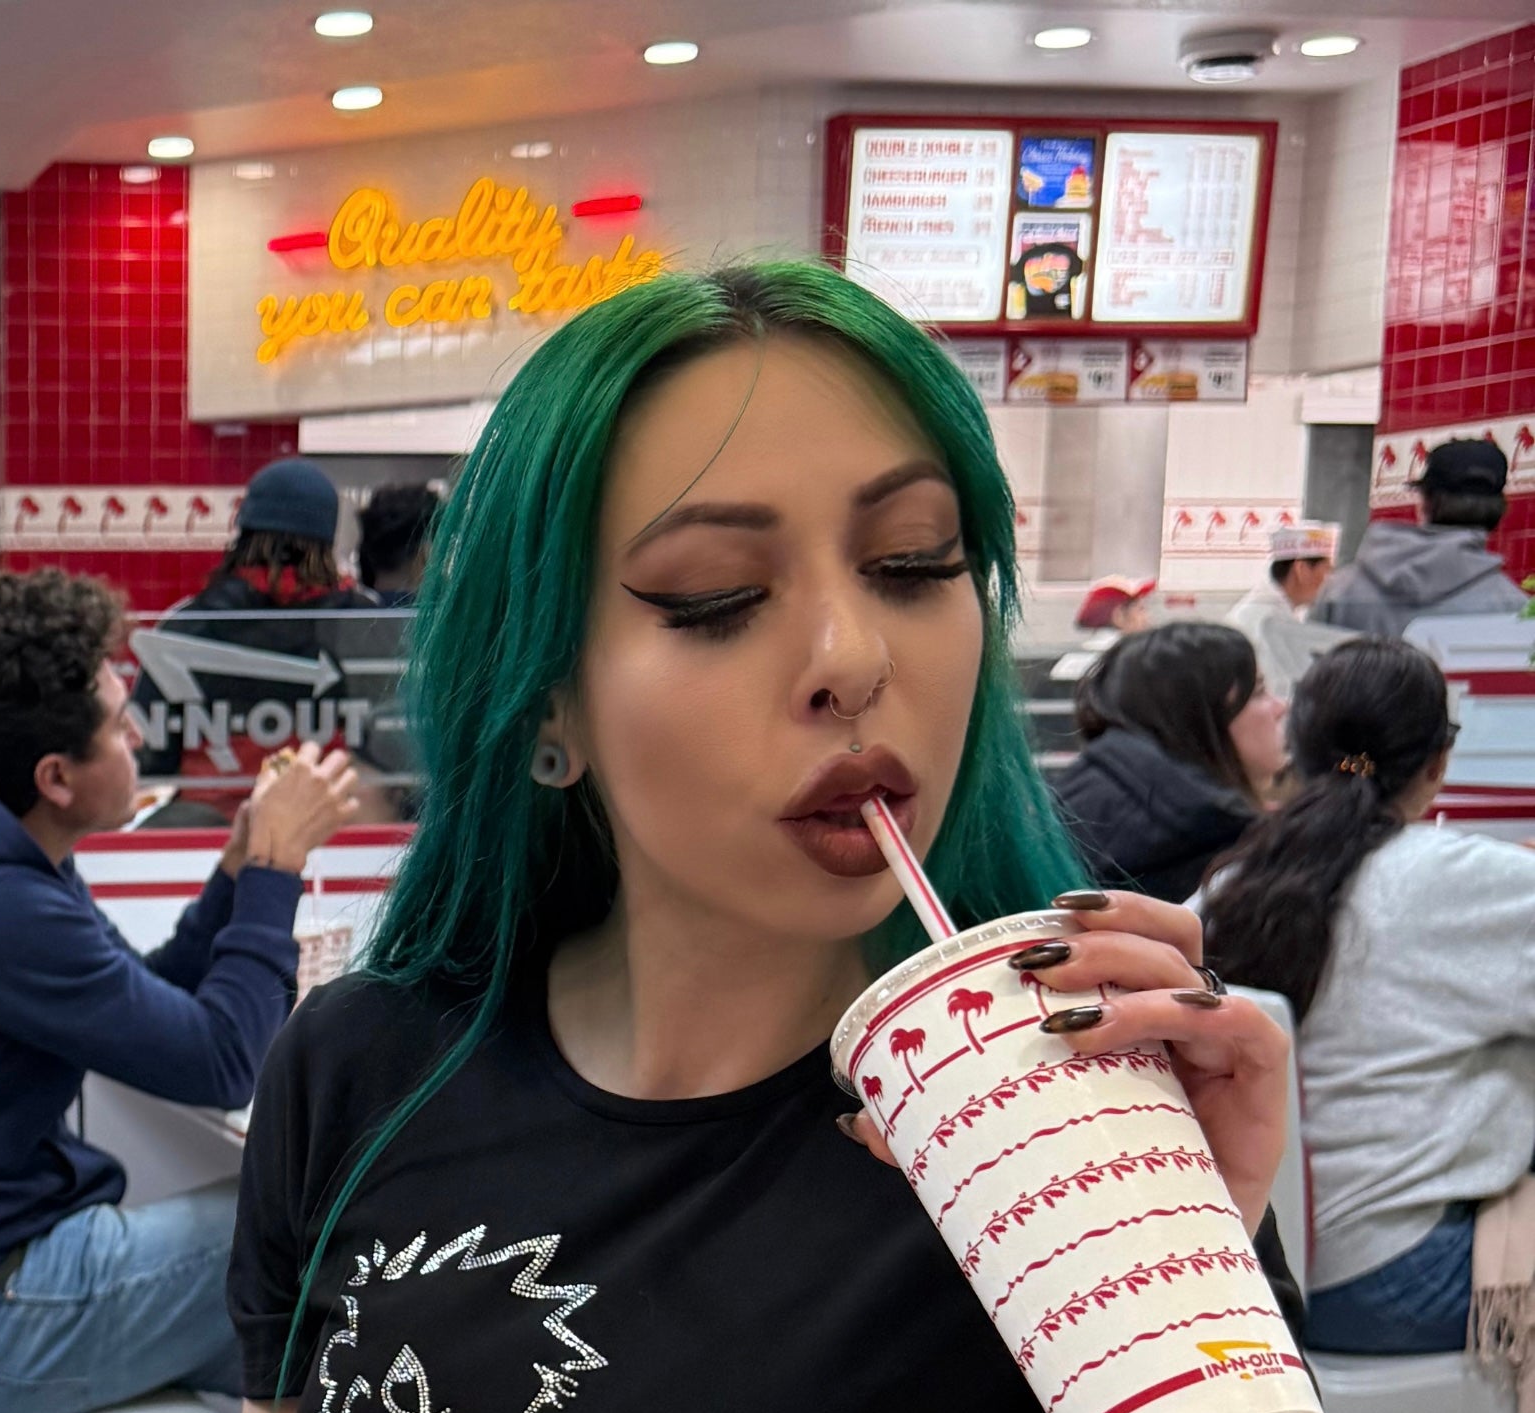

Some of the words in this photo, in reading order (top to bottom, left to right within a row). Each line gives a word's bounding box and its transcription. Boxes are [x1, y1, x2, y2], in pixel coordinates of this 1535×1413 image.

[328, 177, 562, 273] Quality
[257, 289, 368, 364] you
[385, 273, 492, 327] can
[128, 699, 369, 752] N-N-OUT
[1205, 1352, 1281, 1380] IN-N-OUT
